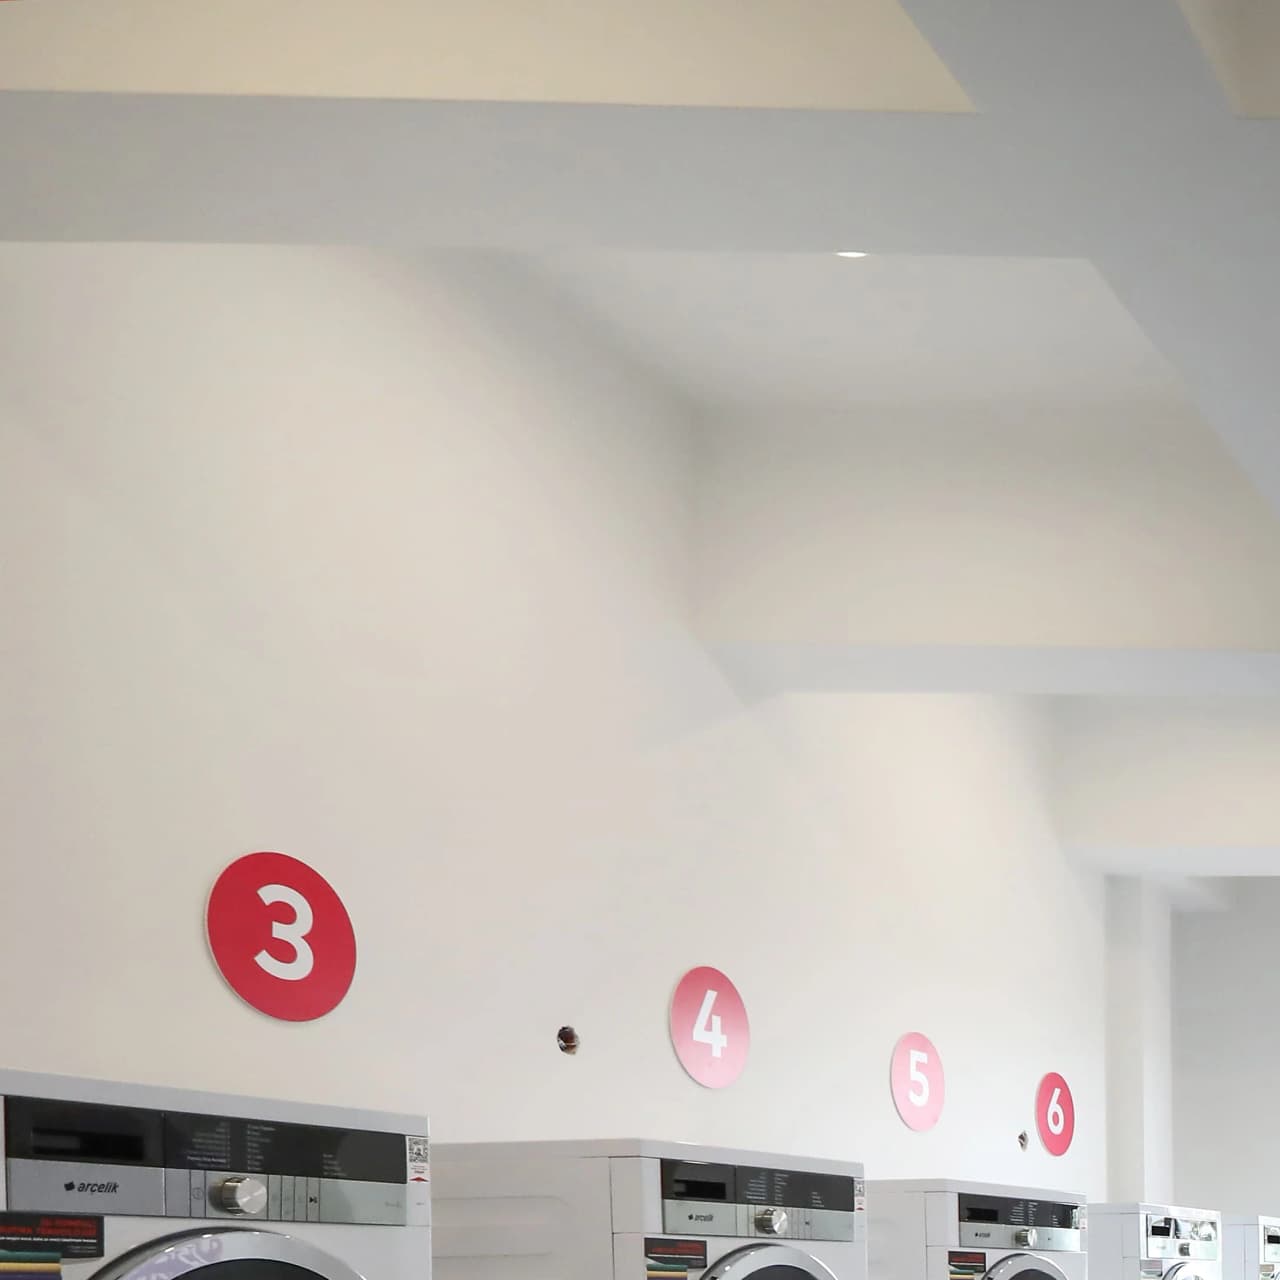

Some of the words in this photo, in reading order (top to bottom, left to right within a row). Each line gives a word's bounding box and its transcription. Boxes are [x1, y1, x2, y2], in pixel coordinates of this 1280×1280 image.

[253, 883, 315, 981] 3
[692, 989, 728, 1057] 4
[908, 1048, 930, 1107] 5
[1046, 1086, 1065, 1135] 6
[77, 1179, 120, 1195] arçelik
